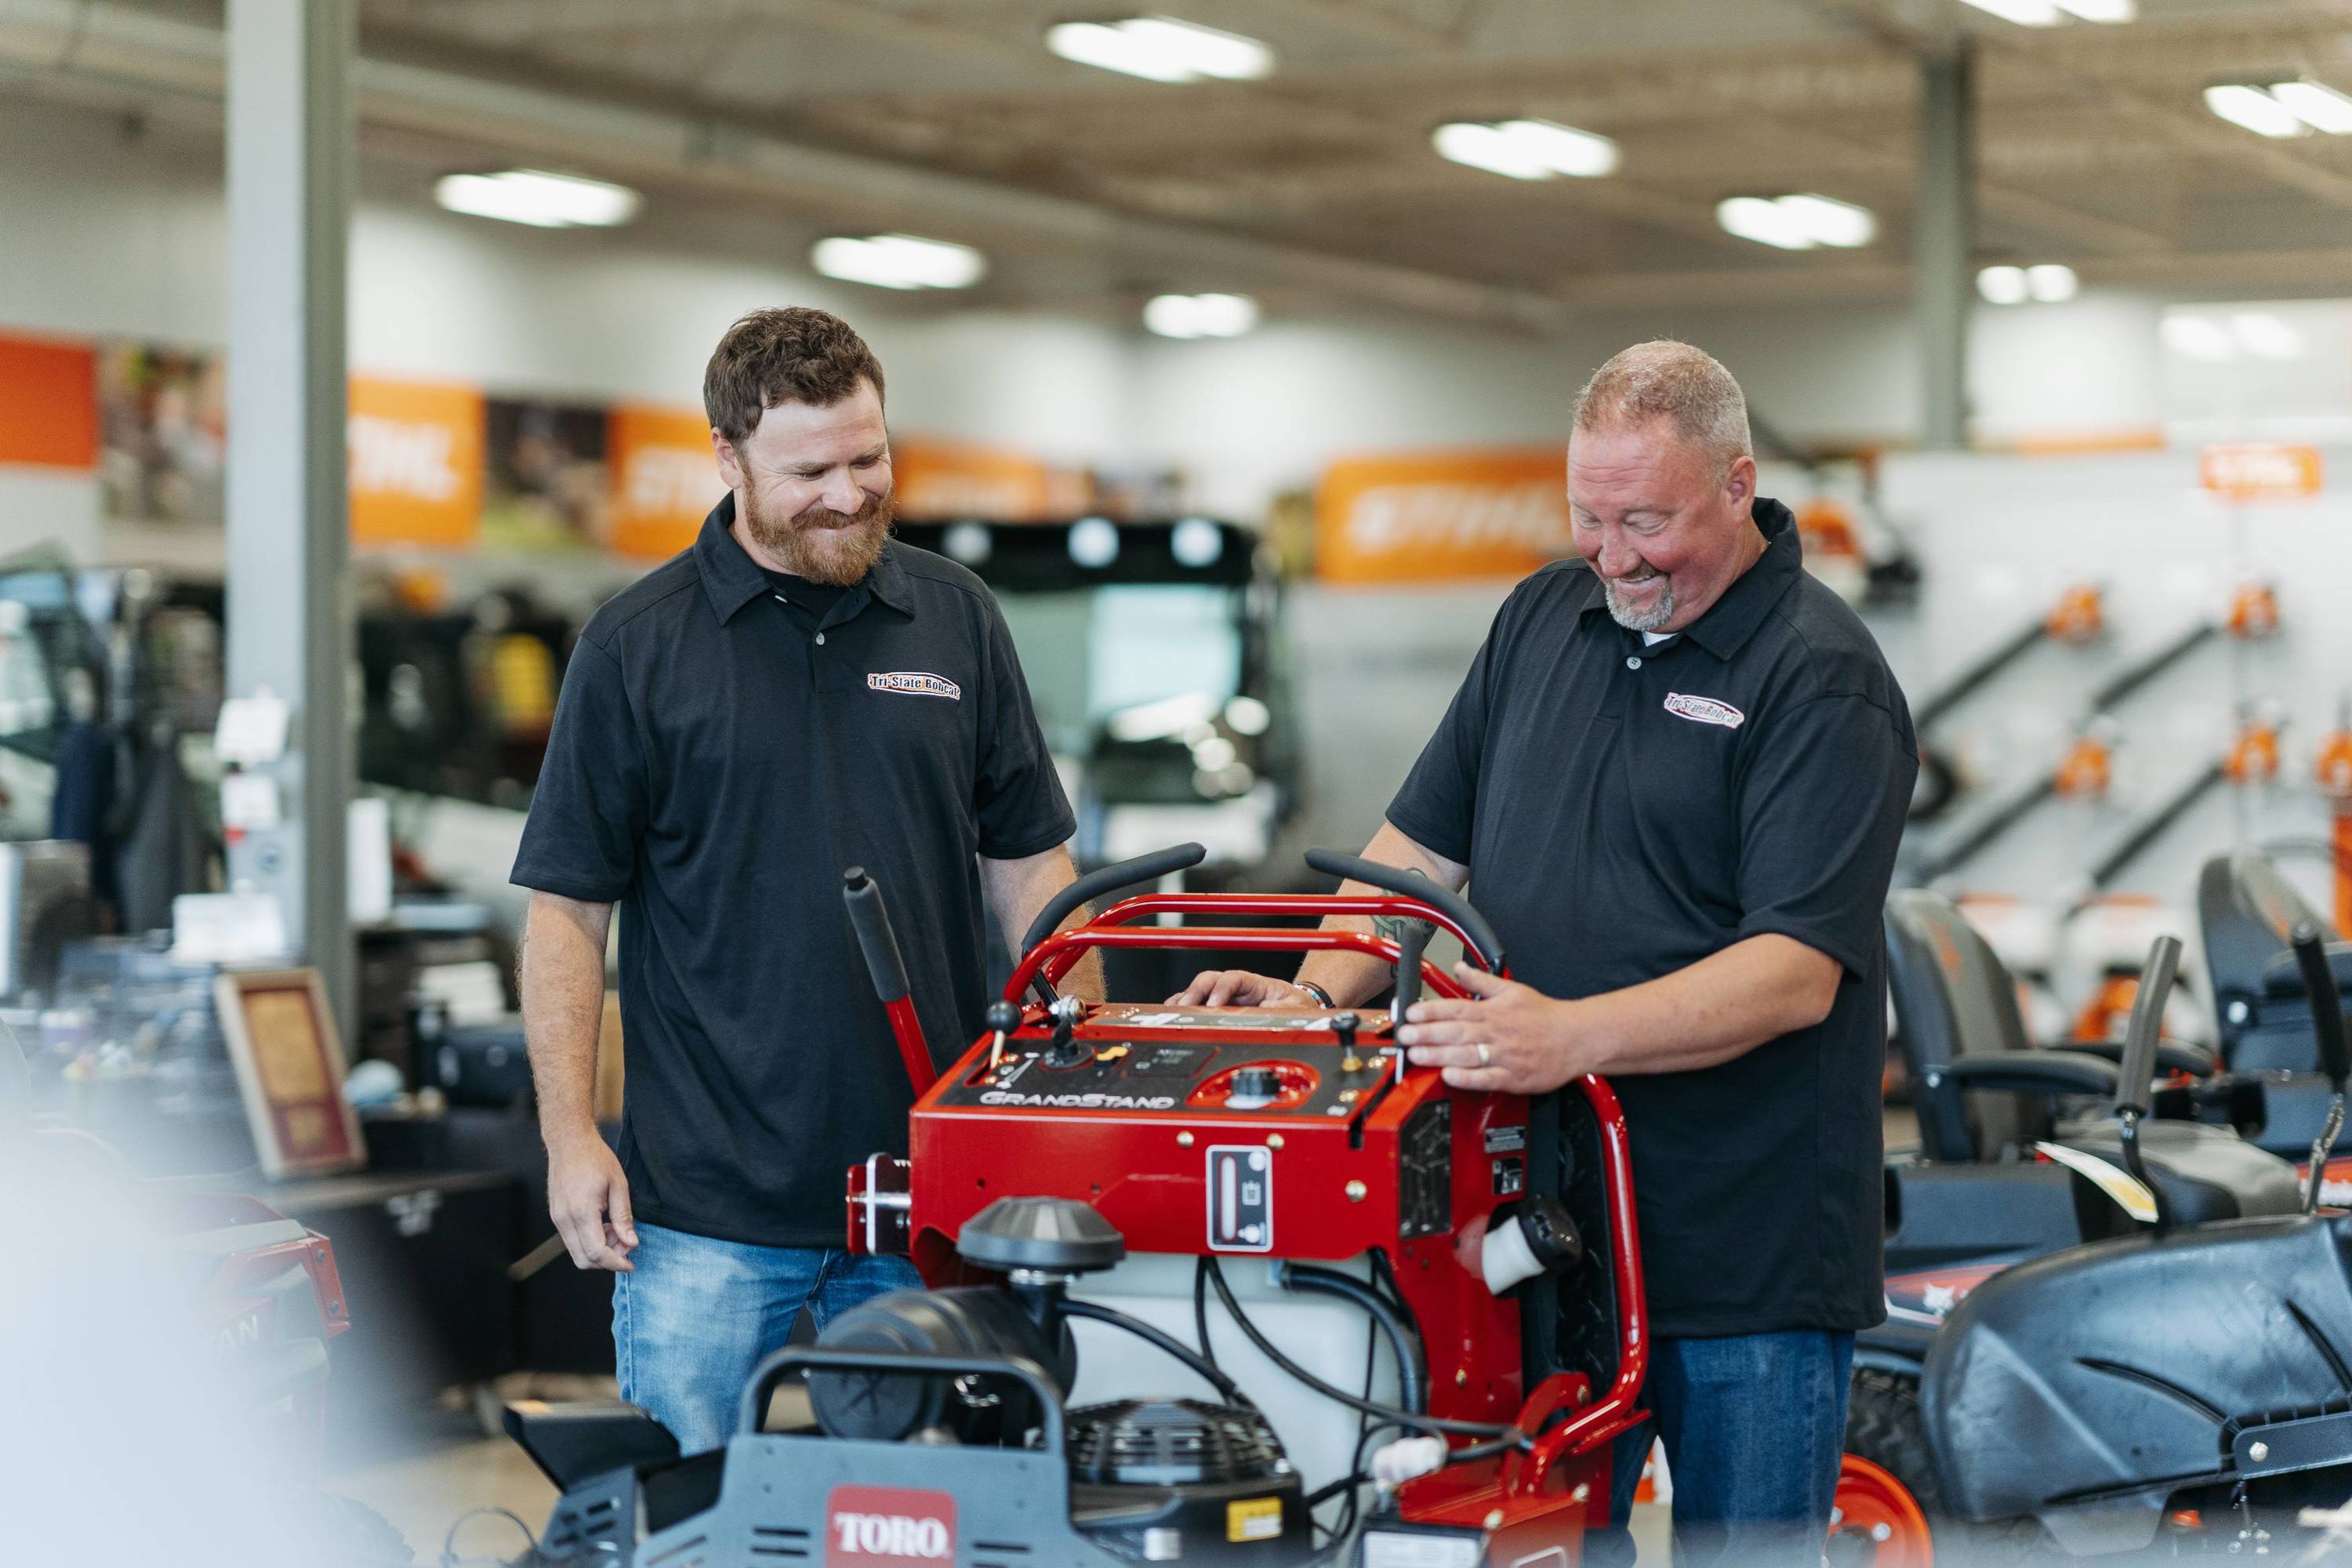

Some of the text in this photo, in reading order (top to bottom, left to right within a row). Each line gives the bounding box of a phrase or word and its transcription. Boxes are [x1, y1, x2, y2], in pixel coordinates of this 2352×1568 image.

[871, 676, 960, 697] Tri-State Bobcat
[1668, 695, 1704, 714] Tri-State
[833, 1512, 949, 1558] TORO
